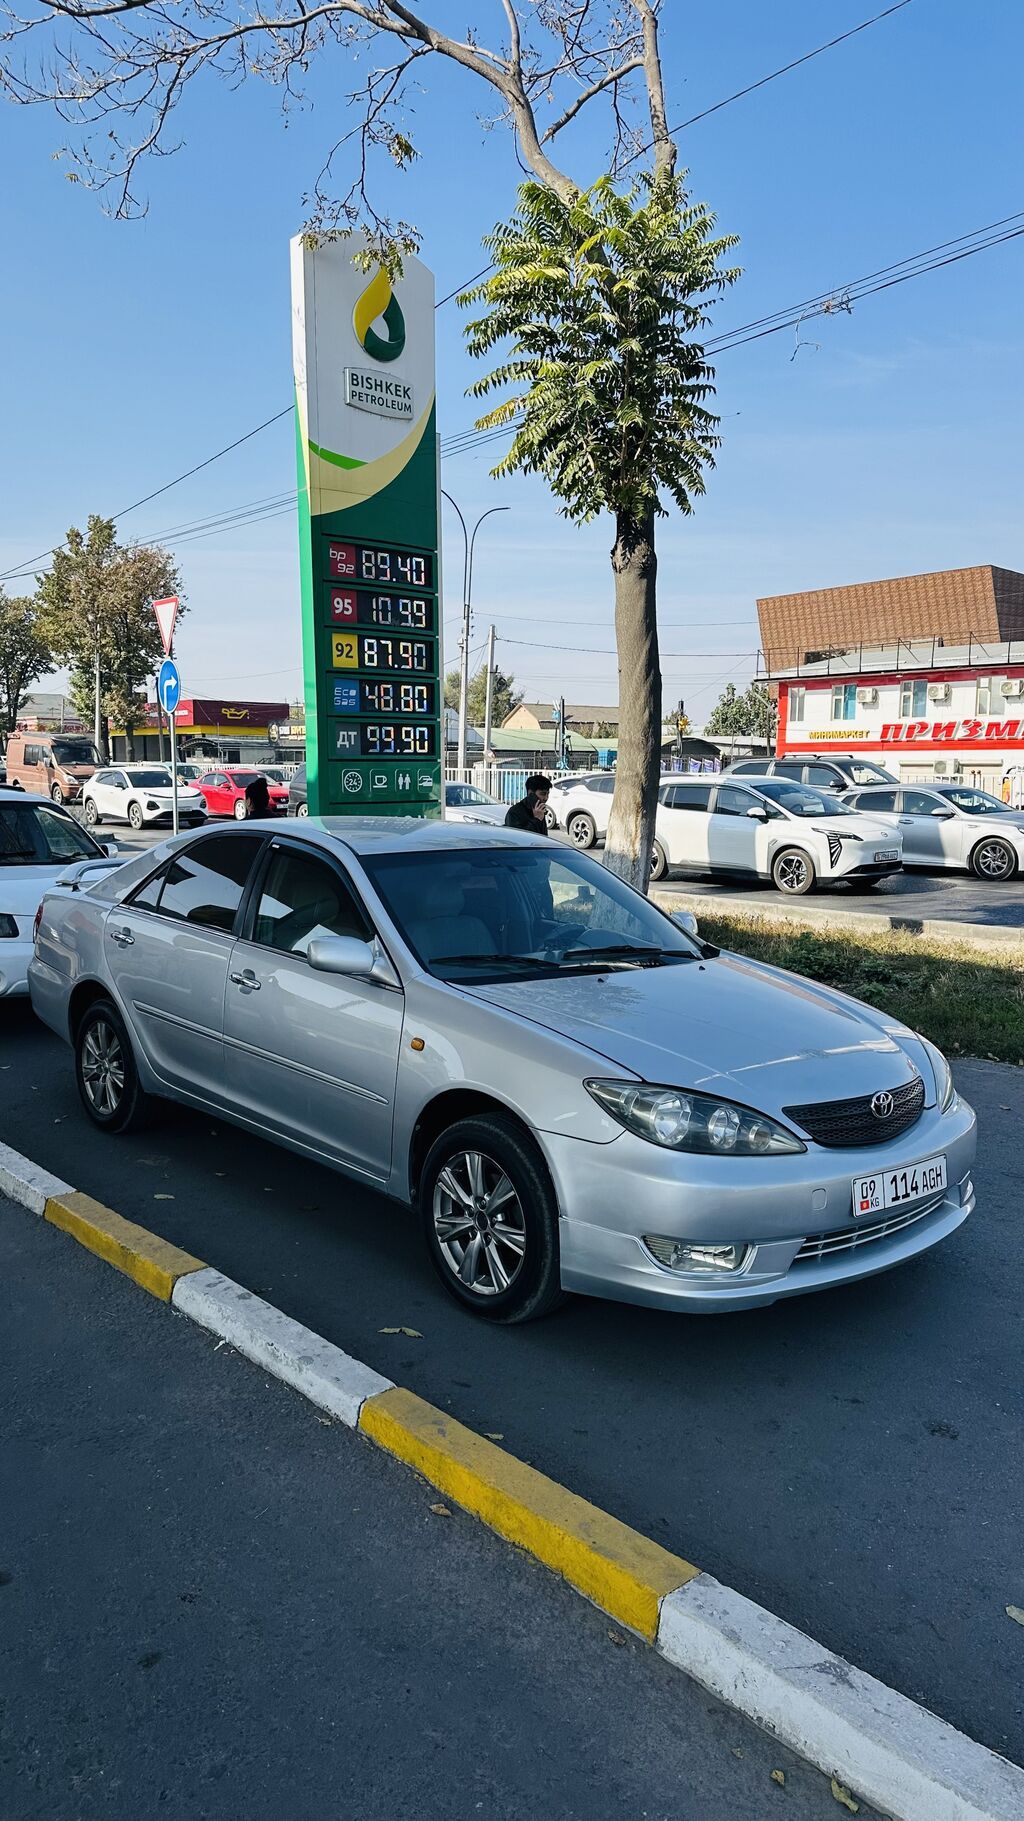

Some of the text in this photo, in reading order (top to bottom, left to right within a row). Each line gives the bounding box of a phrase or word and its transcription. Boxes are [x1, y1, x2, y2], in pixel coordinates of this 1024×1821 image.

[351, 373, 411, 400] BISHKEK
[351, 390, 412, 413] PETROLEUM
[329, 548, 346, 561] bp
[337, 563, 355, 574] 92
[362, 549, 425, 586] 89.40
[333, 597, 353, 615] 95
[335, 642, 354, 659] 92
[364, 638, 427, 671] 87.90
[334, 687, 357, 697] Eco
[365, 684, 427, 712] 48.80
[334, 697, 356, 706] Gas
[366, 725, 428, 754] 99.90
[809, 730, 870, 740] МИНИМАРКЕТ
[880, 718, 1024, 743] ПРИЗМ
[336, 731, 358, 749] ДТ
[348, 778, 358, 787] 24
[860, 1165, 943, 1203] 09 114 AGH
[870, 1197, 880, 1209] KG
